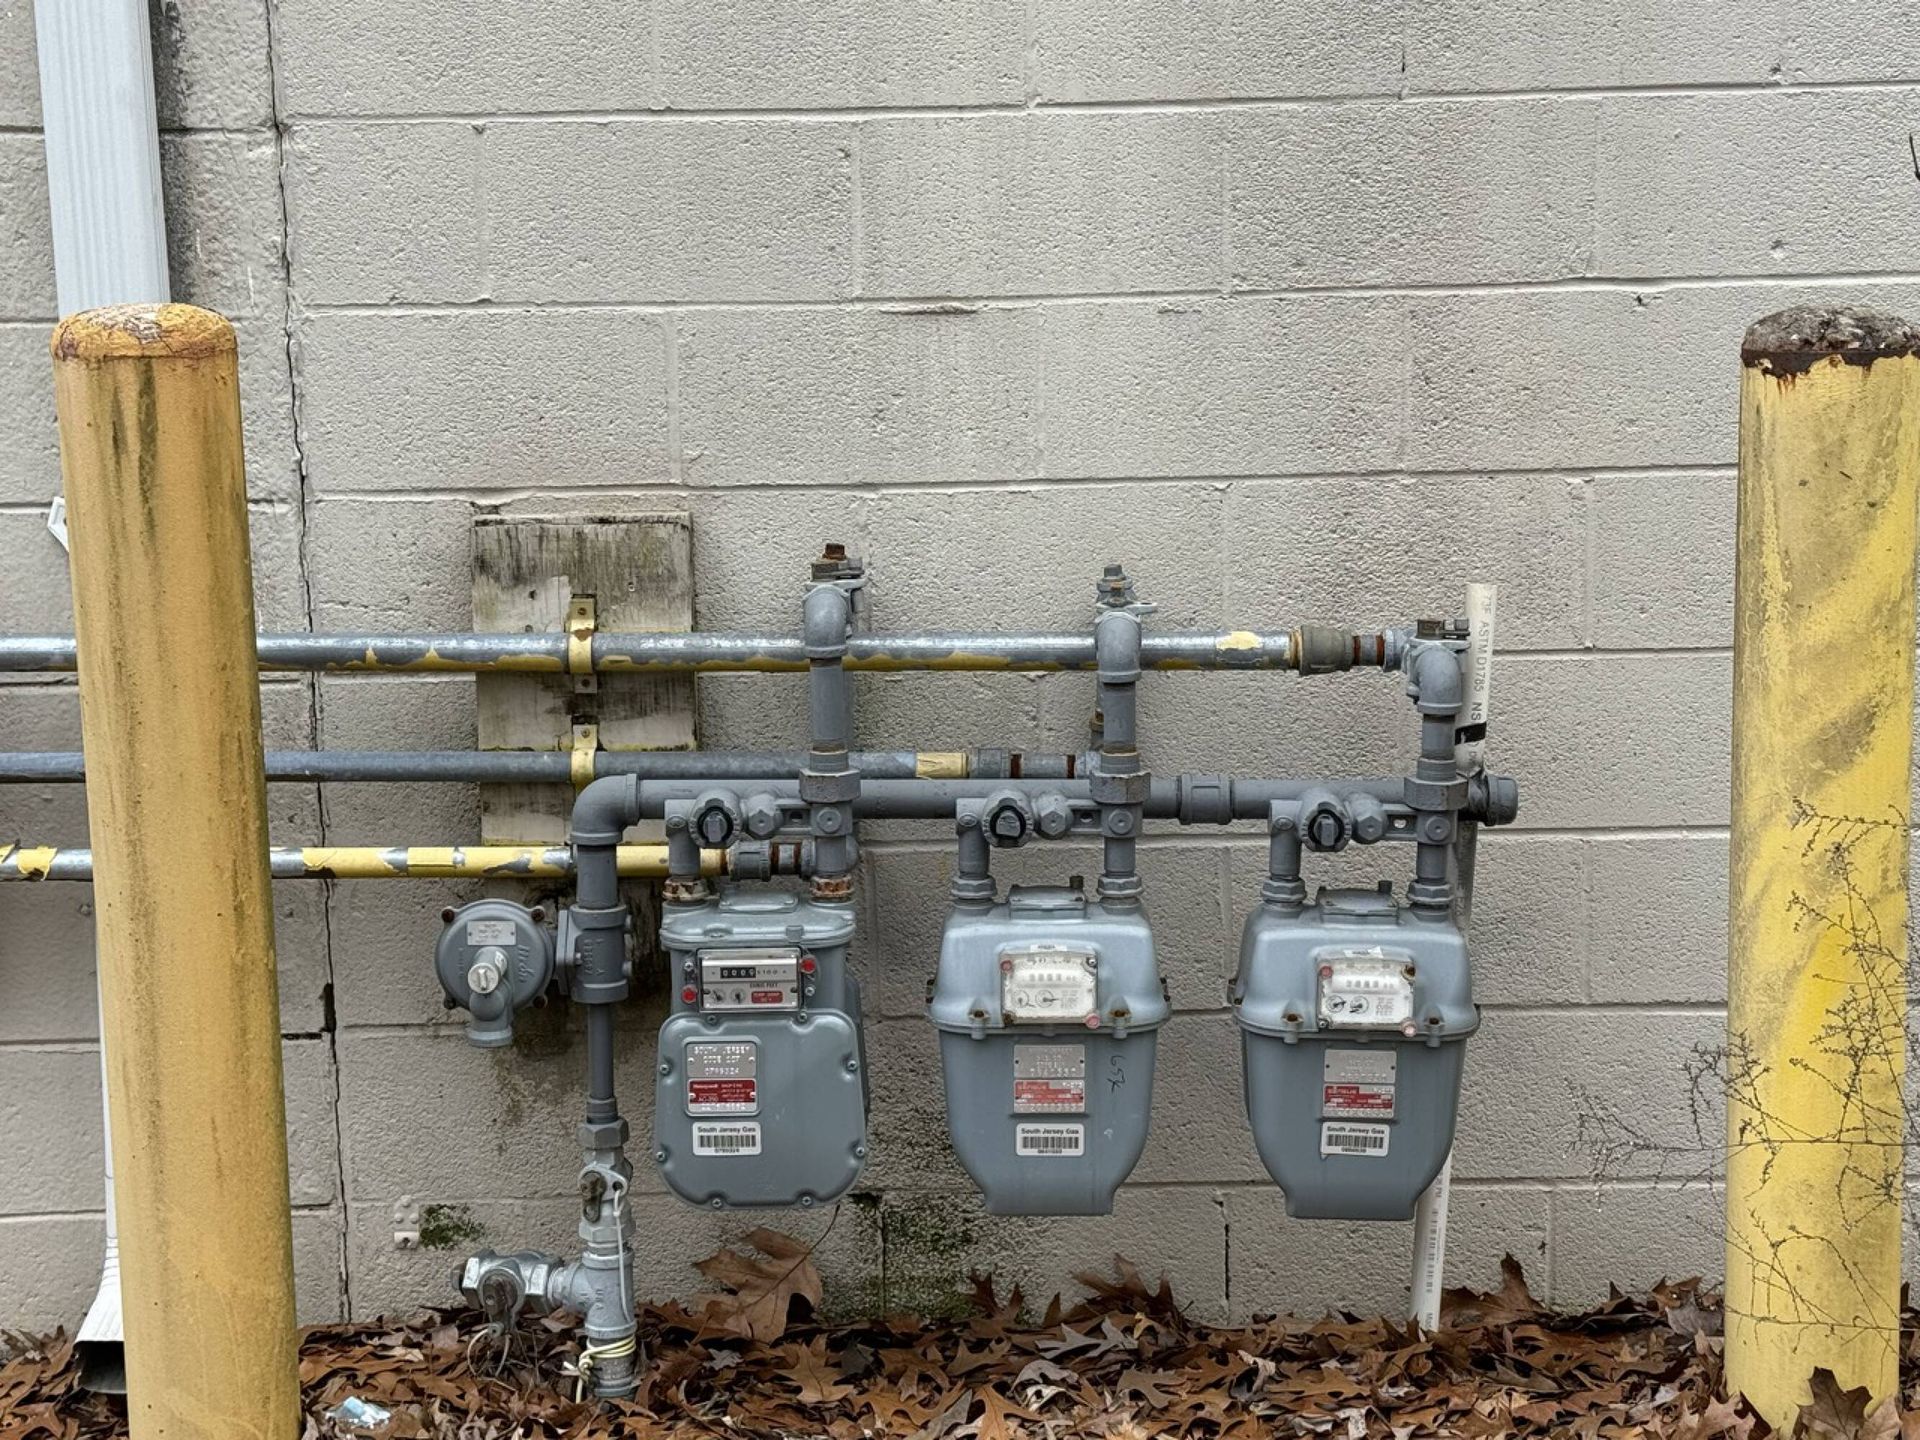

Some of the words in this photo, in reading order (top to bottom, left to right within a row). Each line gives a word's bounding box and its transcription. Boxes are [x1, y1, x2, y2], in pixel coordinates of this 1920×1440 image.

[1478, 620, 1490, 653] ASTM
[1474, 656, 1487, 692] D1785
[718, 1126, 741, 1134] Jersey
[1021, 1127, 1041, 1135] South
[1042, 1127, 1064, 1136] Jersey
[1065, 1127, 1080, 1135] Gas
[1347, 1127, 1370, 1135] Jersey
[1371, 1127, 1385, 1135] Gas
